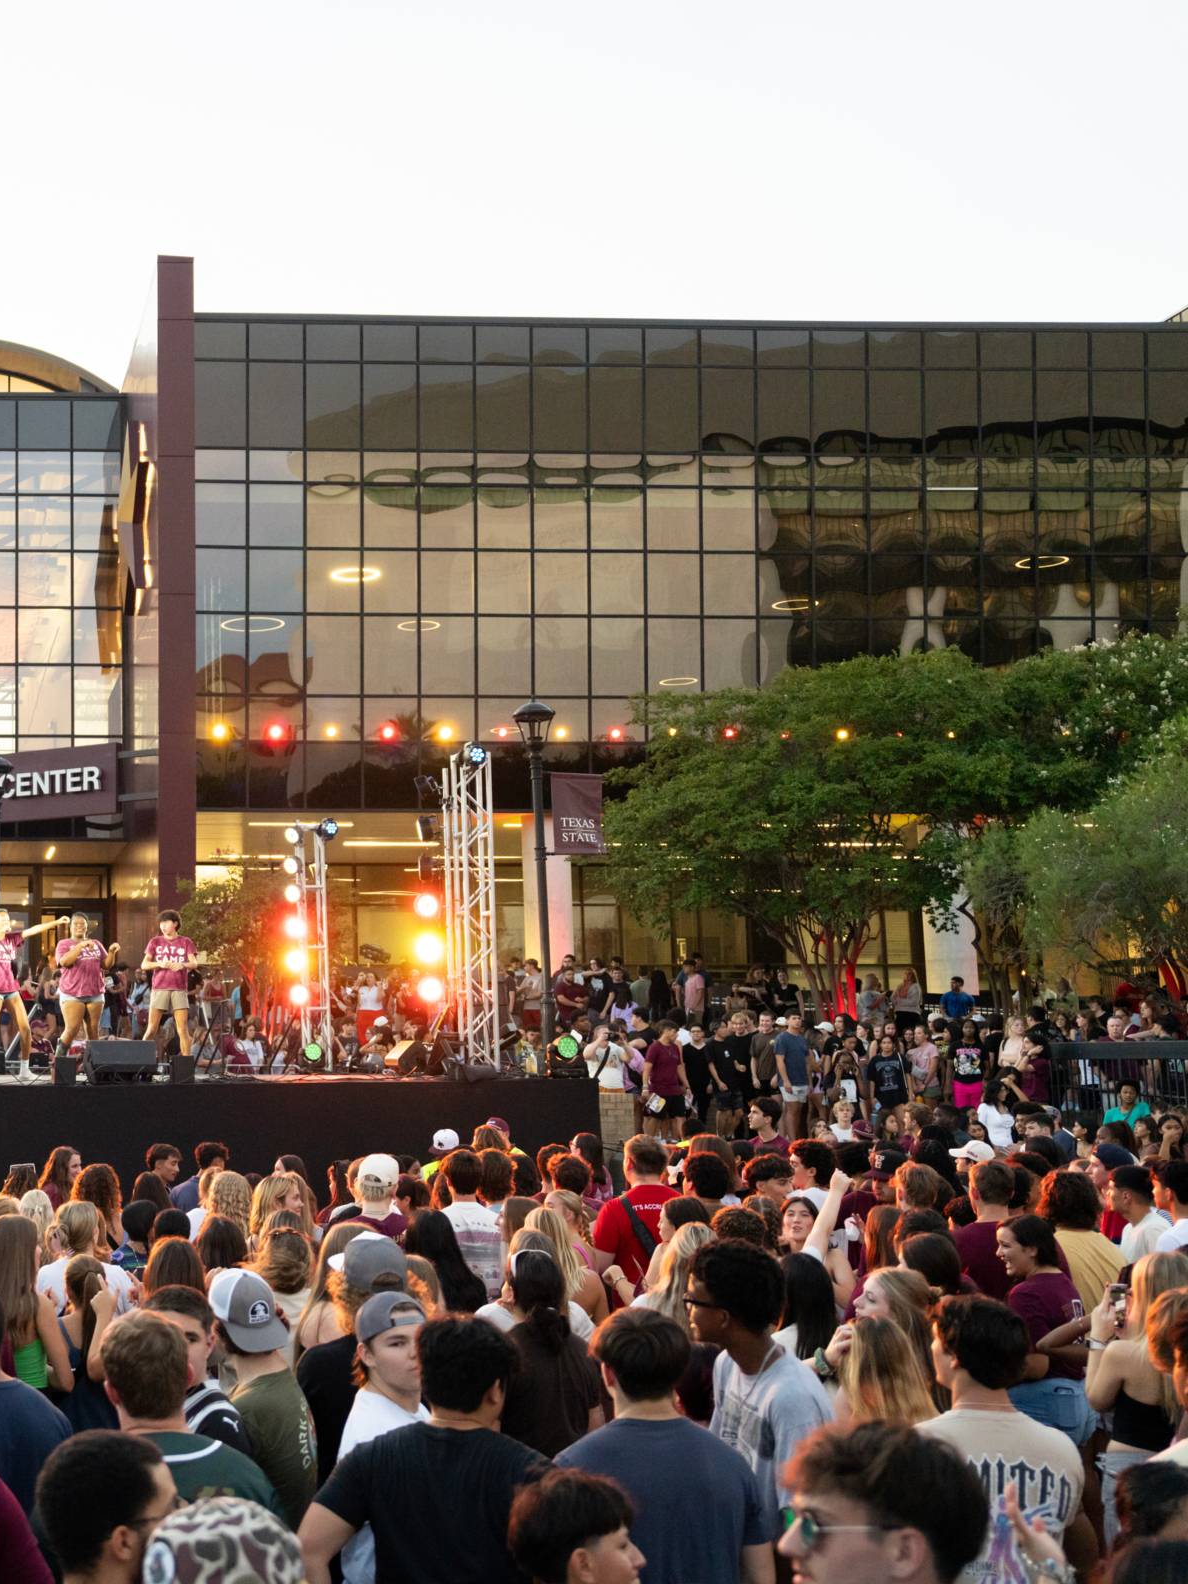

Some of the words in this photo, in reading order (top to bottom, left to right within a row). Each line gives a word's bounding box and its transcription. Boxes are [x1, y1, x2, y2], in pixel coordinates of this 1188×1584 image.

[560, 817, 595, 829] TEXAS
[562, 832, 597, 843] STATE
[155, 945, 176, 954] CAT
